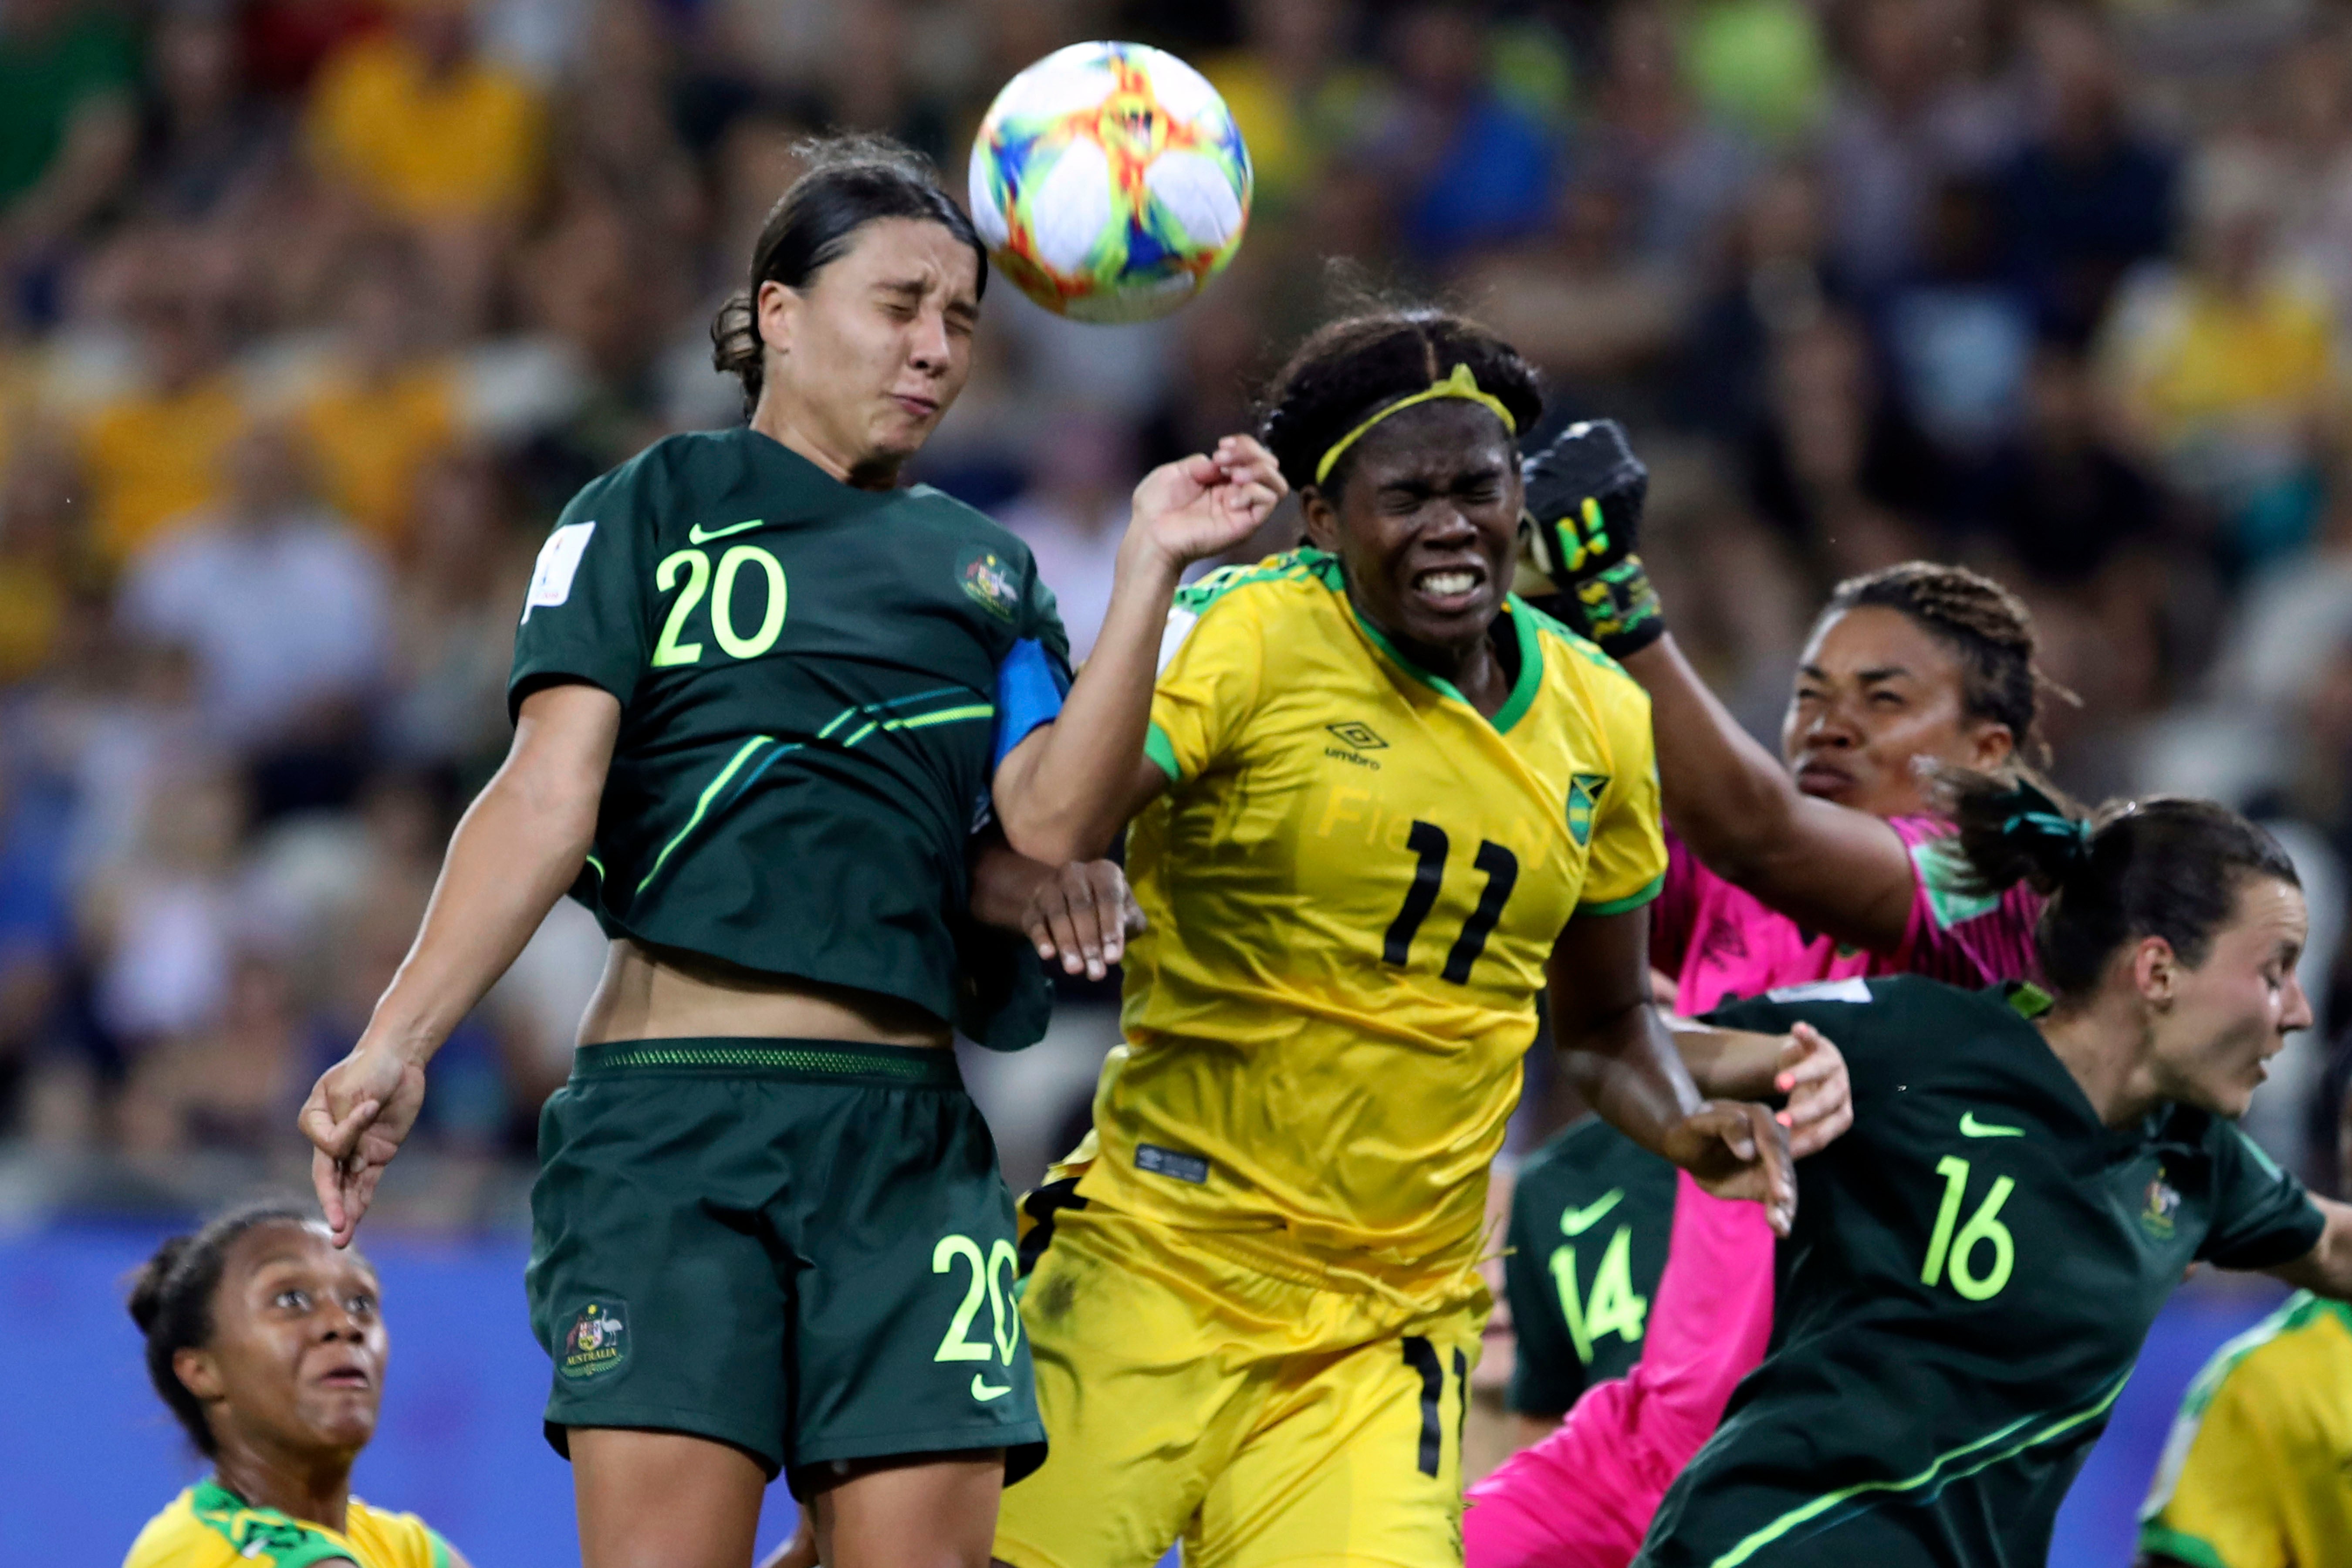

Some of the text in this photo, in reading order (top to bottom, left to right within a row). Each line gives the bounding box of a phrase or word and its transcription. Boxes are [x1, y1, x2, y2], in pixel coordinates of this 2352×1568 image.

[652, 545, 788, 667] 20
[1324, 747, 1380, 771] umbro
[1382, 820, 1519, 986] 11
[1548, 1224, 1648, 1365] 14
[1920, 1155, 2015, 1301] 16
[567, 1347, 617, 1365] AUSTRALIA
[932, 1233, 1021, 1366] 20
